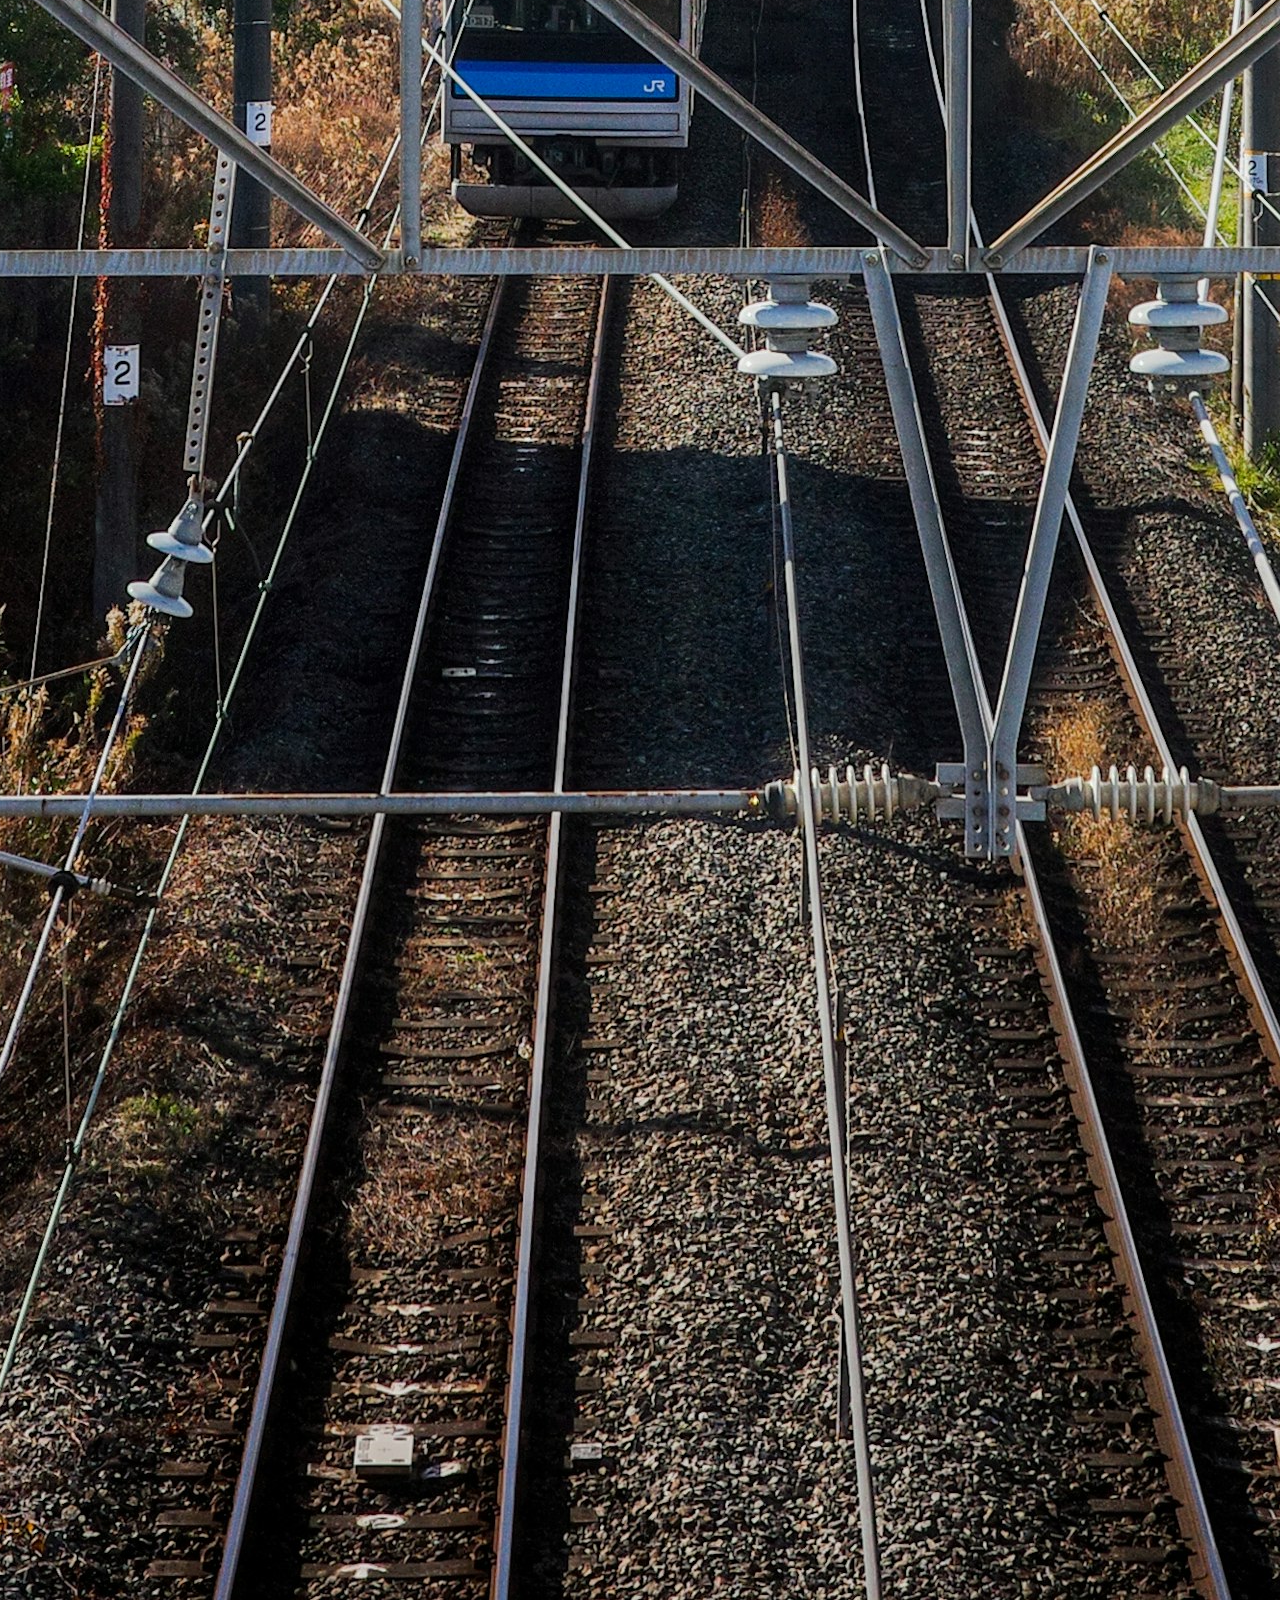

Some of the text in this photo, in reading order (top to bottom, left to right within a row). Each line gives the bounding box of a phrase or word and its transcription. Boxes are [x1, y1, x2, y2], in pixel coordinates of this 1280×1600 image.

[643, 80, 666, 93] JR
[255, 113, 266, 131] 2
[1248, 160, 1257, 176] 2
[115, 361, 131, 385] 2
